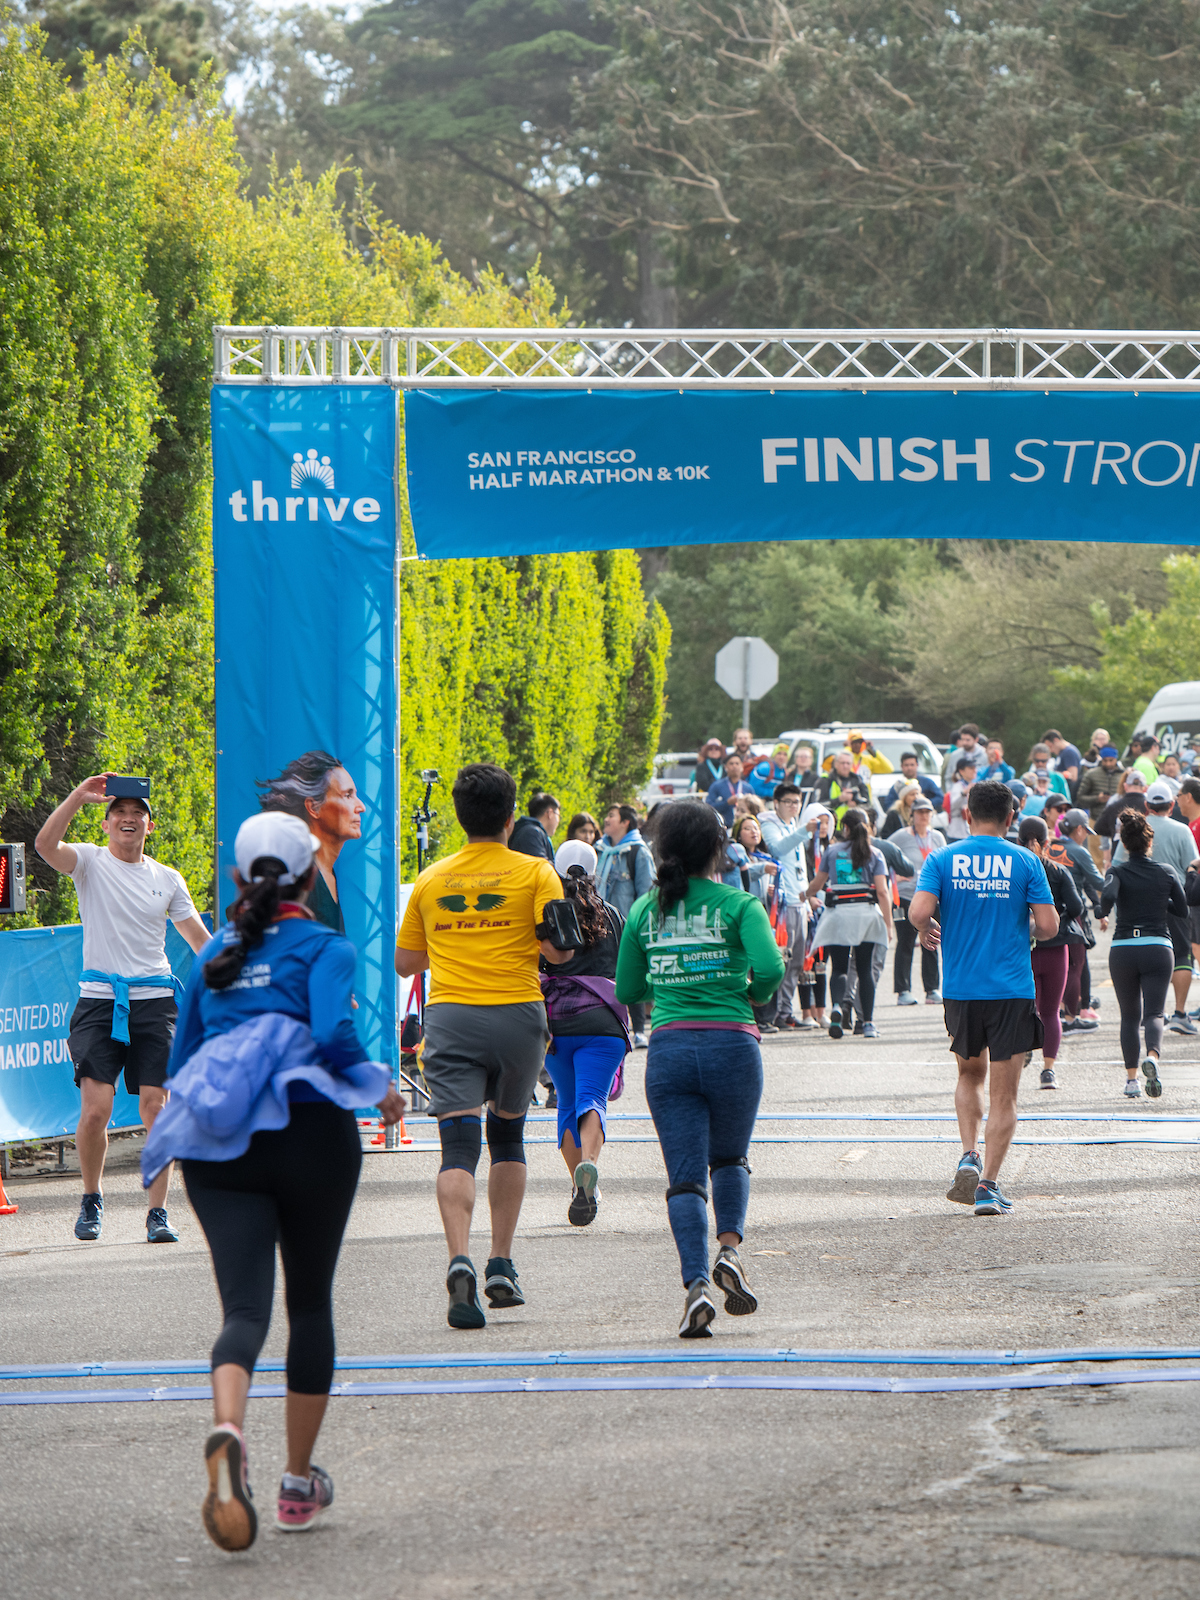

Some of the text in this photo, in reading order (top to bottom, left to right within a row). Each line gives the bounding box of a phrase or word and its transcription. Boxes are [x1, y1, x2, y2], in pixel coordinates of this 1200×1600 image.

[467, 449, 637, 468] SAN FRANCISCO
[761, 437, 992, 484] FINISH
[469, 471, 523, 490] HALF
[528, 467, 653, 486] MARATHON
[229, 480, 381, 522] thrive
[1162, 732, 1191, 754] SVE
[952, 854, 1013, 879] RUN
[951, 878, 1011, 891] TOGETHER
[697, 958, 731, 967] FRANCISCO
[664, 974, 706, 984] MARATHON
[52, 1002, 69, 1028] BY
